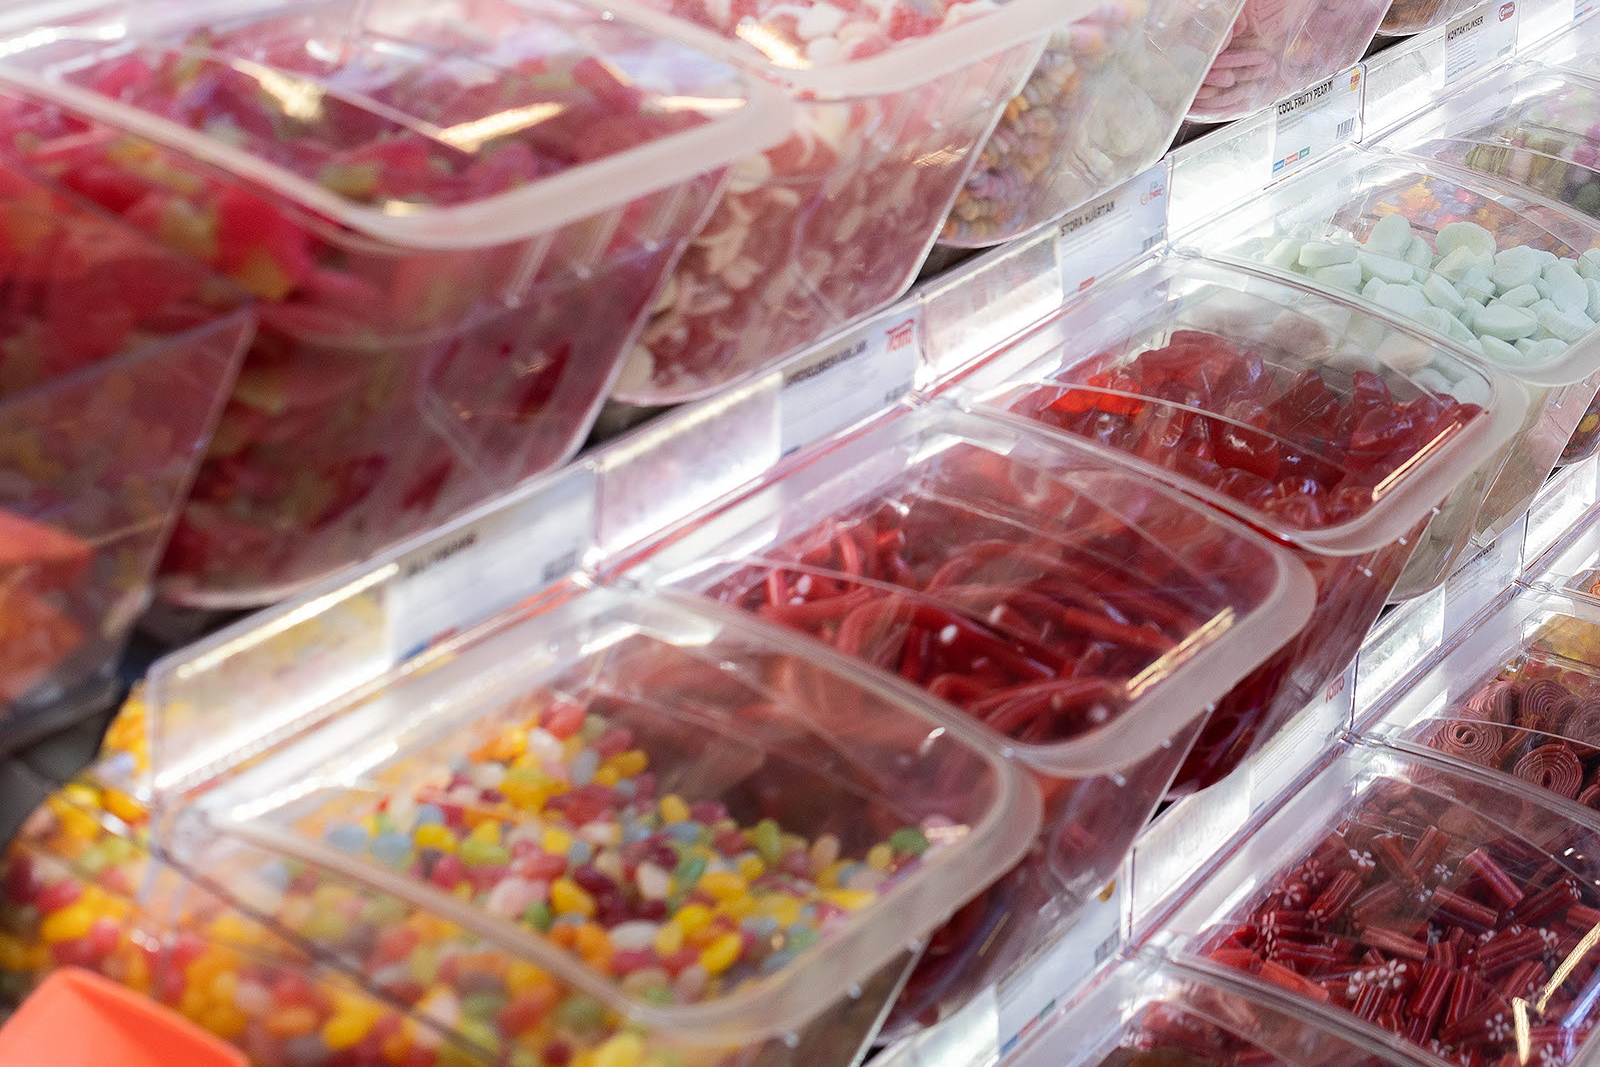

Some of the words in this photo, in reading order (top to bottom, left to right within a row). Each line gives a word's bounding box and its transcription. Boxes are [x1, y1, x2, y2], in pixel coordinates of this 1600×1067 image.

[1446, 15, 1484, 43] KONTAKTLINSER
[1278, 99, 1294, 115] COOL
[1294, 87, 1314, 109] FRUITY
[1313, 83, 1328, 100] PEAR
